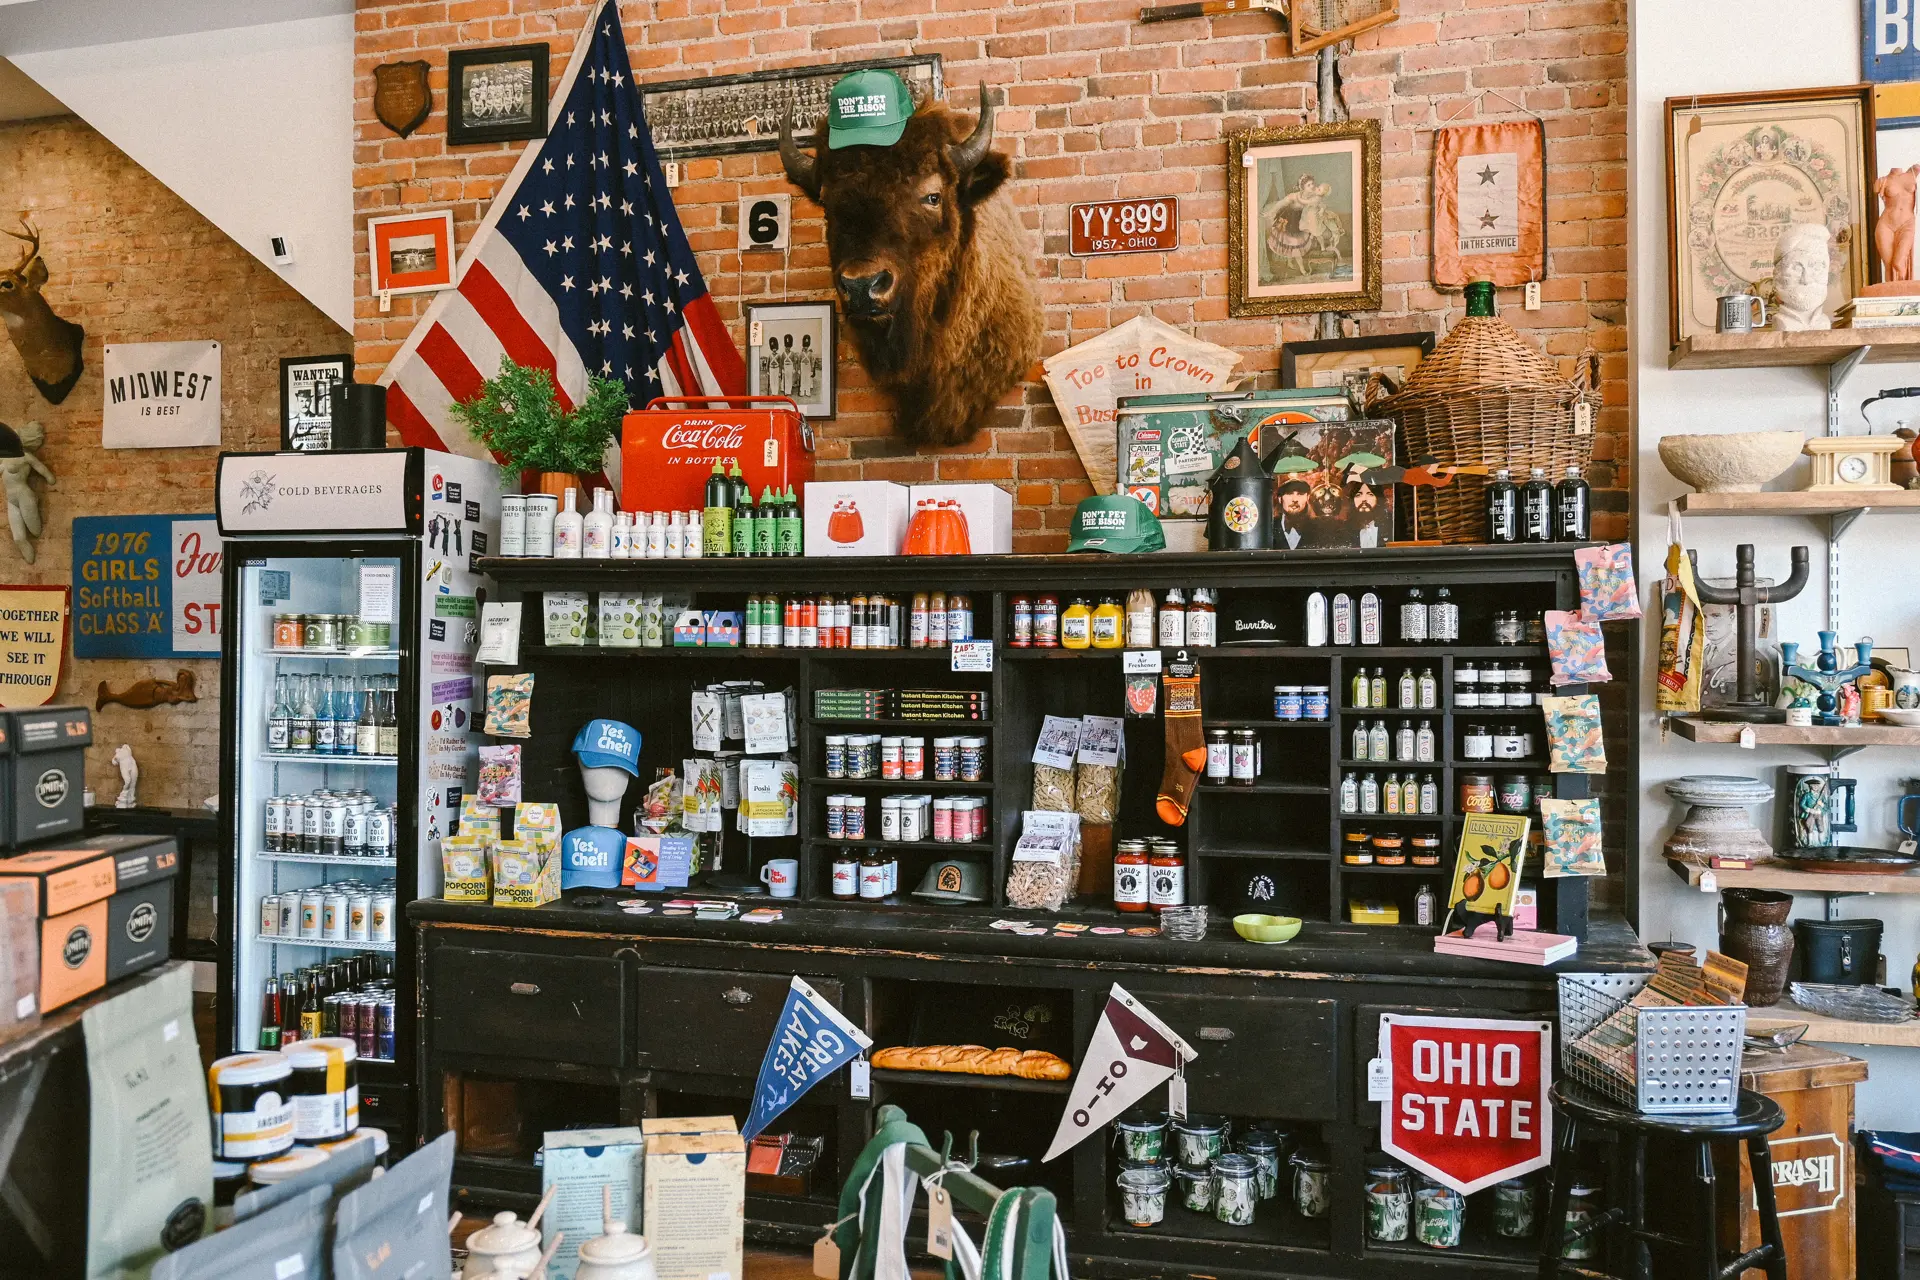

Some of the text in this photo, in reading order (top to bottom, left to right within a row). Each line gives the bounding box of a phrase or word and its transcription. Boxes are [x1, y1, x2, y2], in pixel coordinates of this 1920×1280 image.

[838, 95, 886, 106] DON'T PET
[839, 103, 886, 114] THE BISON
[748, 200, 779, 243] 6
[1092, 236, 1157, 250] 1957 OHIO
[1460, 238, 1516, 250] IN THE SERVICE
[1115, 346, 1214, 384] to Crown
[293, 368, 339, 381] WANTED
[1064, 364, 1104, 391] Toe
[1134, 373, 1152, 390] in
[110, 370, 212, 404] MIDWEST
[141, 404, 182, 416] IS BEST
[685, 456, 738, 464] BOTTES
[1178, 456, 1208, 464] PARTICIPANT
[278, 484, 382, 498] COLD BEVERAGES
[1082, 518, 1126, 526] THE BISON
[92, 532, 151, 554] 1976
[82, 558, 160, 581] GIRLS
[80, 586, 160, 610] Softball
[0, 610, 59, 622] OGETHER
[184, 602, 221, 634] ST
[79, 612, 164, 636] CLASS 'A'
[1234, 618, 1277, 631] Burritos
[0, 630, 55, 644] WE WILL
[954, 644, 974, 653] ZAB'S
[6, 652, 46, 664] SEE IT
[1666, 678, 1679, 690] RICE
[602, 723, 626, 742] Yes,
[444, 745, 451, 753] My
[597, 736, 632, 757] Chef!
[445, 771, 451, 779] My
[452, 772, 466, 780] Garden
[1471, 822, 1516, 835] RECIPES
[572, 838, 598, 854] Yes,
[572, 851, 608, 866] Chef!
[770, 868, 782, 878] Yes,
[770, 875, 787, 884] Chef!
[1117, 868, 1140, 877] CARLO'S
[1152, 870, 1177, 878] CARLO'S
[495, 888, 533, 896] POPCORN
[1260, 875, 1274, 897] CERTAIN
[773, 1000, 820, 1076] LAKES
[788, 1028, 845, 1091] GREAT
[1412, 1040, 1521, 1087] OHIO
[1401, 1093, 1532, 1140] STATE
